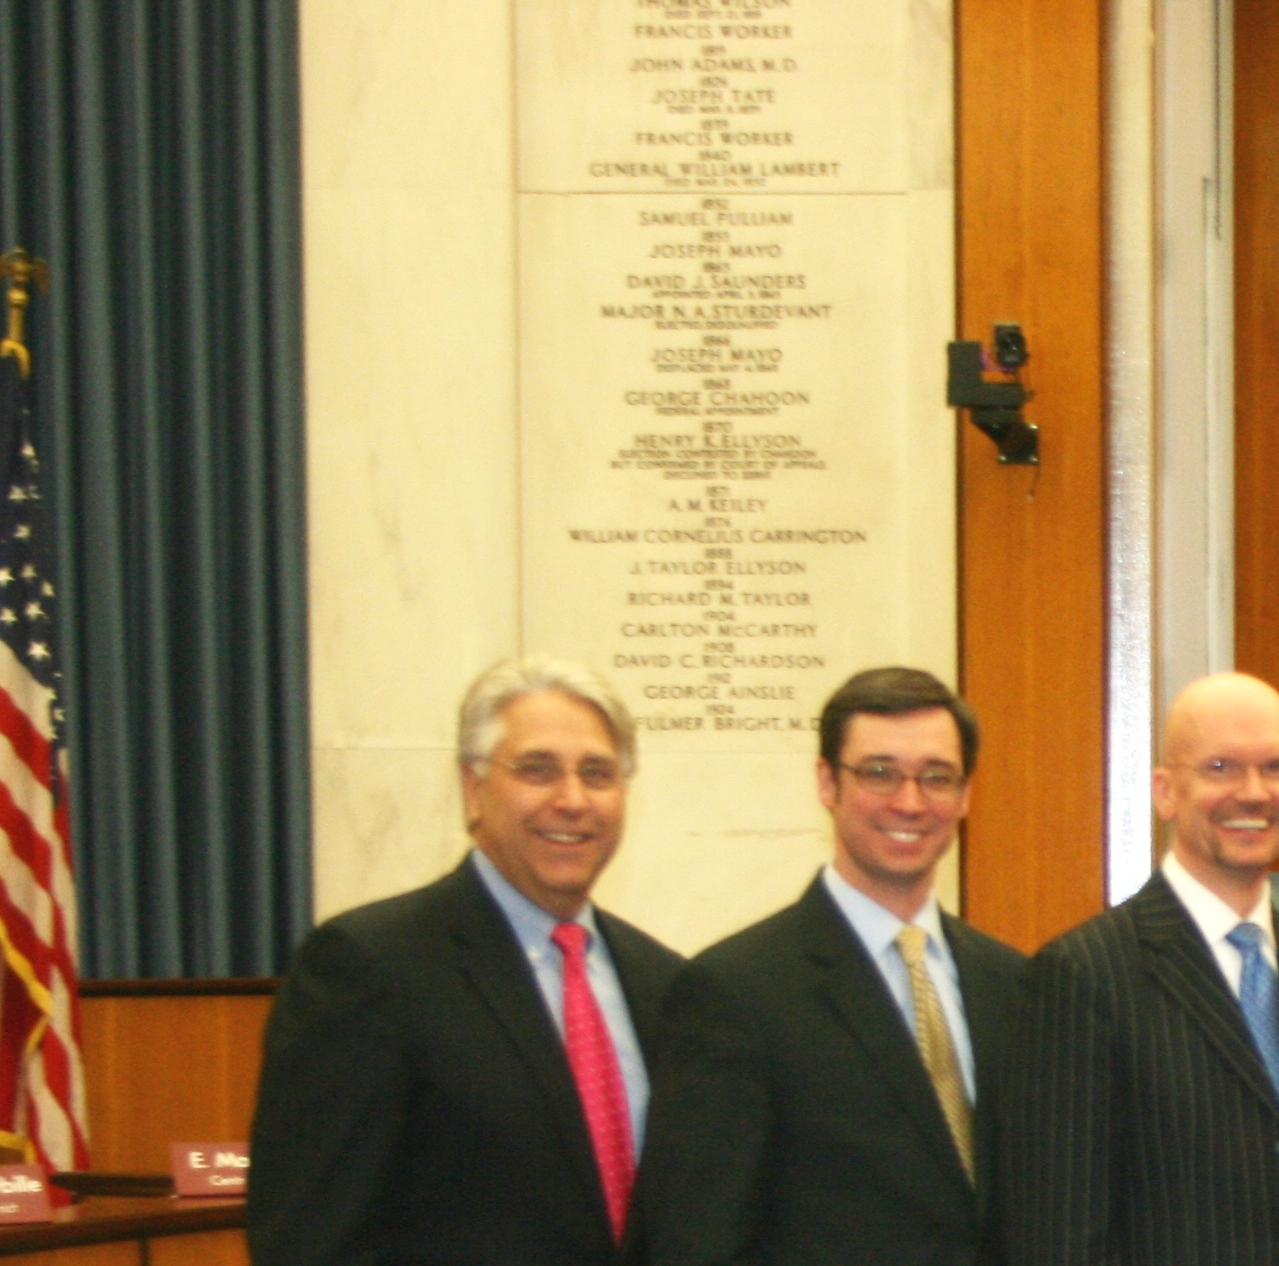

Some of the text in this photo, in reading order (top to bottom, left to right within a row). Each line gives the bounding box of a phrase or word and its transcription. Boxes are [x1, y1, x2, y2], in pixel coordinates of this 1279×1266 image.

[634, 25, 793, 39] FRANCIS WORKER
[629, 58, 683, 73] JOHN
[651, 89, 776, 104] JOSEPH TATE
[635, 132, 793, 146] FRANCIS WORKER
[589, 162, 841, 177] GENERAL WILLIAM LAMBERT
[638, 211, 793, 226] SAMUEL PULLIAM
[649, 244, 782, 258] JOSEPH MAYO
[626, 274, 685, 289] DAVID
[710, 274, 807, 289] SAUNDERS
[600, 304, 664, 319] MAJOR
[712, 304, 832, 319] STURDEVANT
[650, 348, 783, 362] JOSEPH MAYO
[624, 391, 810, 406] GEORGE CHAHOON
[635, 434, 694, 449] HENRY
[722, 434, 801, 449] ELLYSON
[710, 498, 769, 512] KEILEY
[568, 529, 867, 543] WILLIAM CORNELIUS CARRINGTON
[648, 560, 718, 575] TAYLOR
[725, 560, 807, 575] ELLYSON
[628, 592, 712, 606] RICHARD
[742, 592, 811, 606] TAYLOR
[703, 611, 735, 623] 1904
[621, 623, 818, 638] CARLTON McCARTHY
[703, 641, 735, 653] 1908
[613, 654, 672, 669] DAVID
[703, 654, 825, 669] RICHARDSON
[643, 685, 796, 700] GEORGE AINSLIE
[635, 717, 705, 732] FULMER
